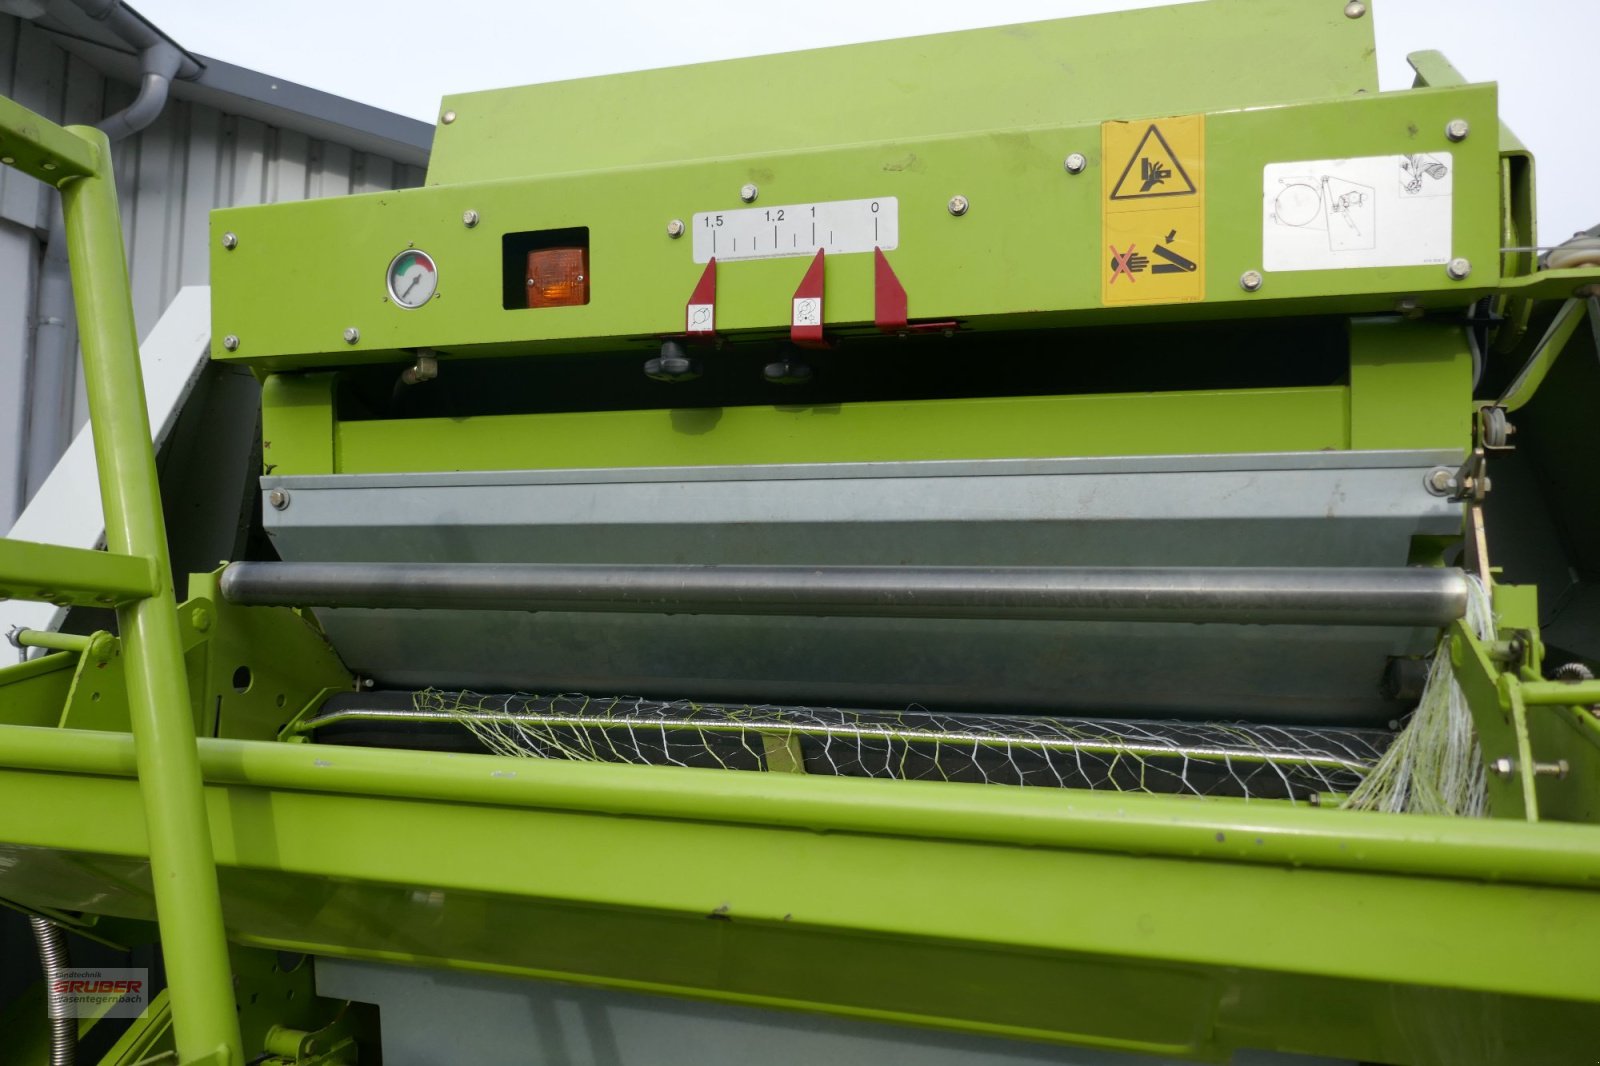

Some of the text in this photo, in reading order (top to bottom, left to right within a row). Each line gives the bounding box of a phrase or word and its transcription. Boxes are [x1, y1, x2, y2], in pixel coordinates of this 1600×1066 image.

[704, 202, 880, 228] 1,5 1,2 1 0
